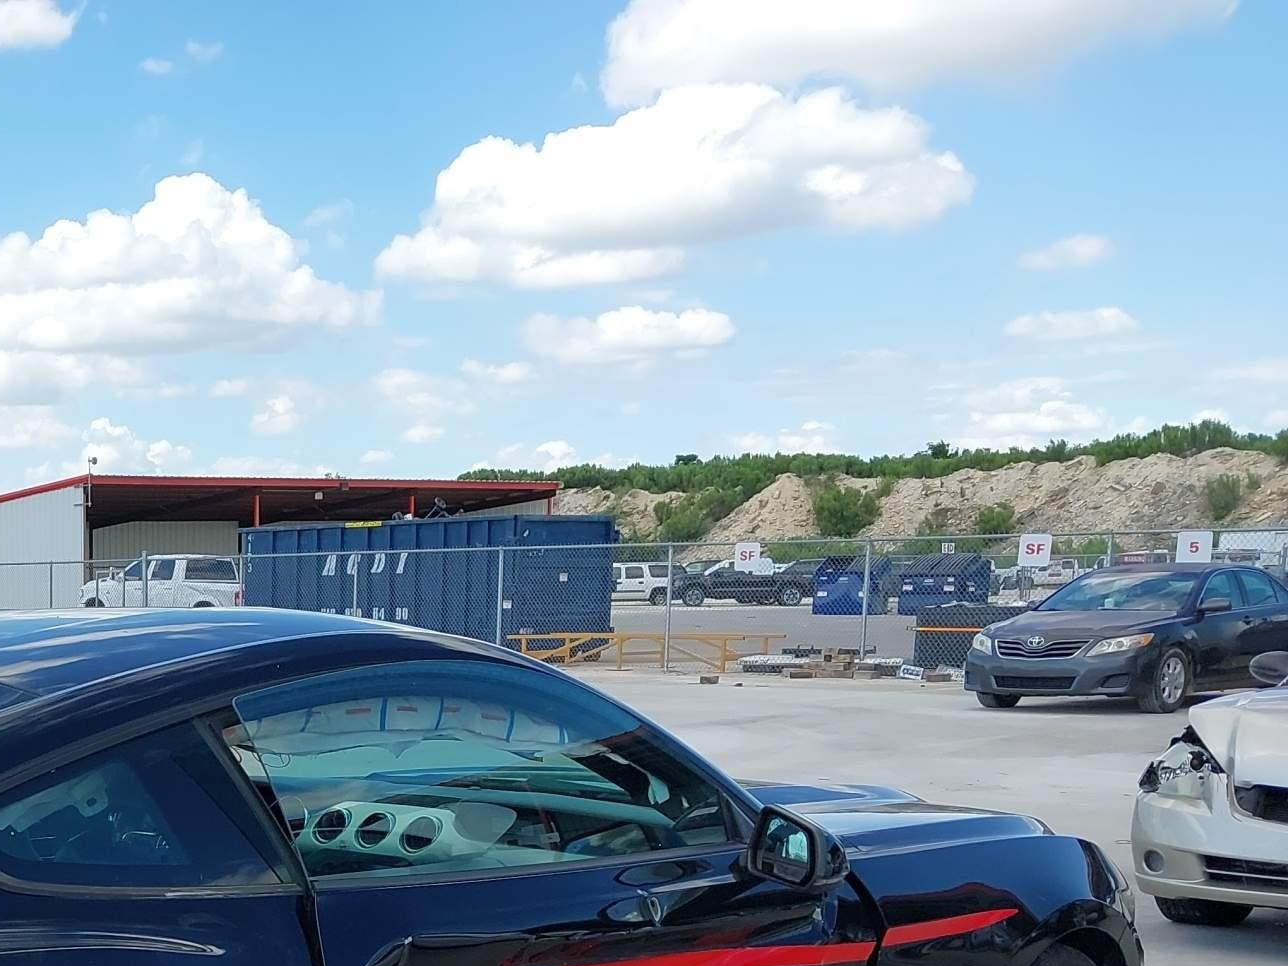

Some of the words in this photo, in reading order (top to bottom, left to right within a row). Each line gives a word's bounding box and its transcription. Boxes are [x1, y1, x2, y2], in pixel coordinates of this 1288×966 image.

[1025, 543, 1045, 556] SF
[1189, 541, 1200, 554] 5
[740, 550, 756, 562] SF
